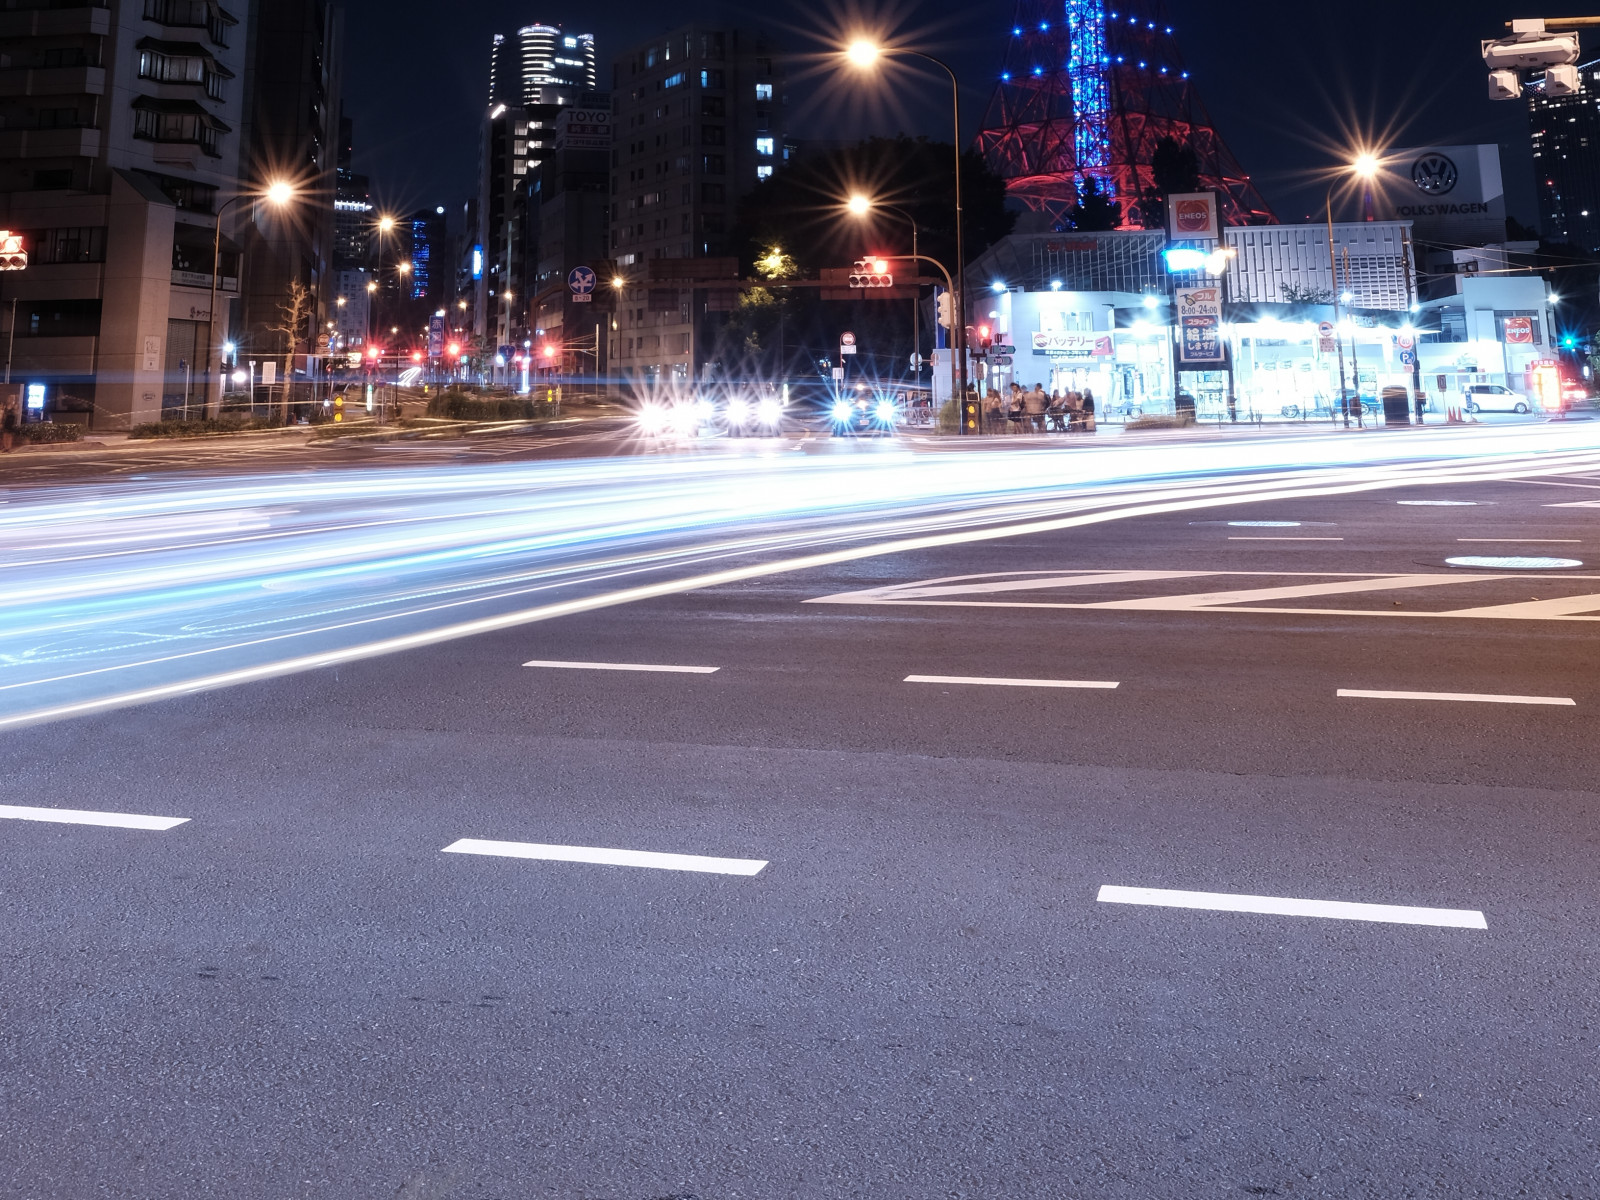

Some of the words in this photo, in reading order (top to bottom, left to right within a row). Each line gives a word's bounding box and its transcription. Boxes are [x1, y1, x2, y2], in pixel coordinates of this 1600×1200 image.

[1179, 212, 1207, 220] ENEOS
[1197, 292, 1212, 300] フル
[1186, 327, 1217, 341] 給油
[1048, 335, 1094, 347] バッテリー
